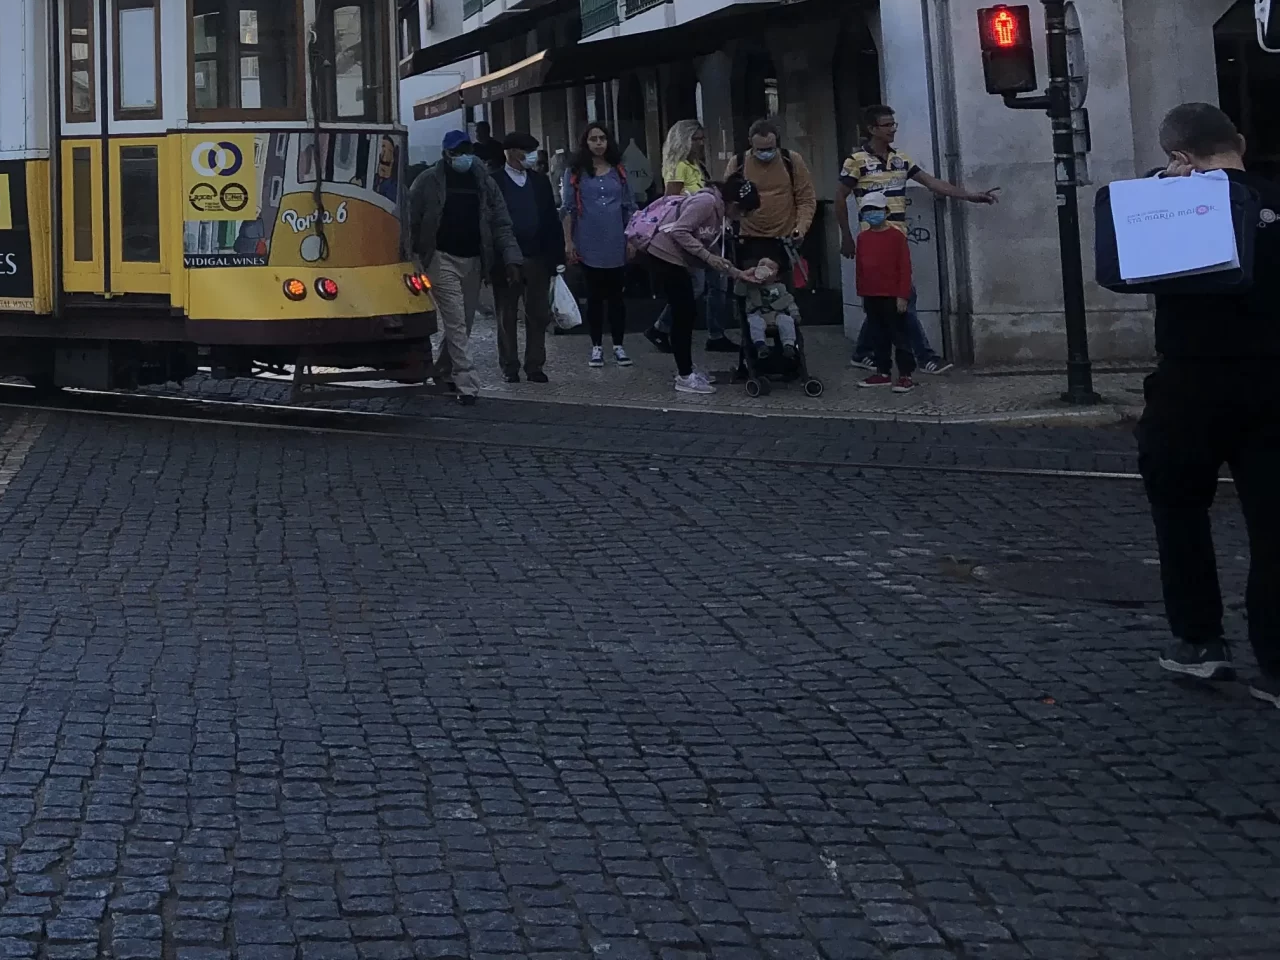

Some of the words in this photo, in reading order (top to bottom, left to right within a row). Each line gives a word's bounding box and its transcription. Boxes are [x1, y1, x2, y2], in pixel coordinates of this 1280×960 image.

[335, 201, 348, 224] 6
[184, 257, 230, 266] VIDIGAL
[232, 257, 265, 265] WINES
